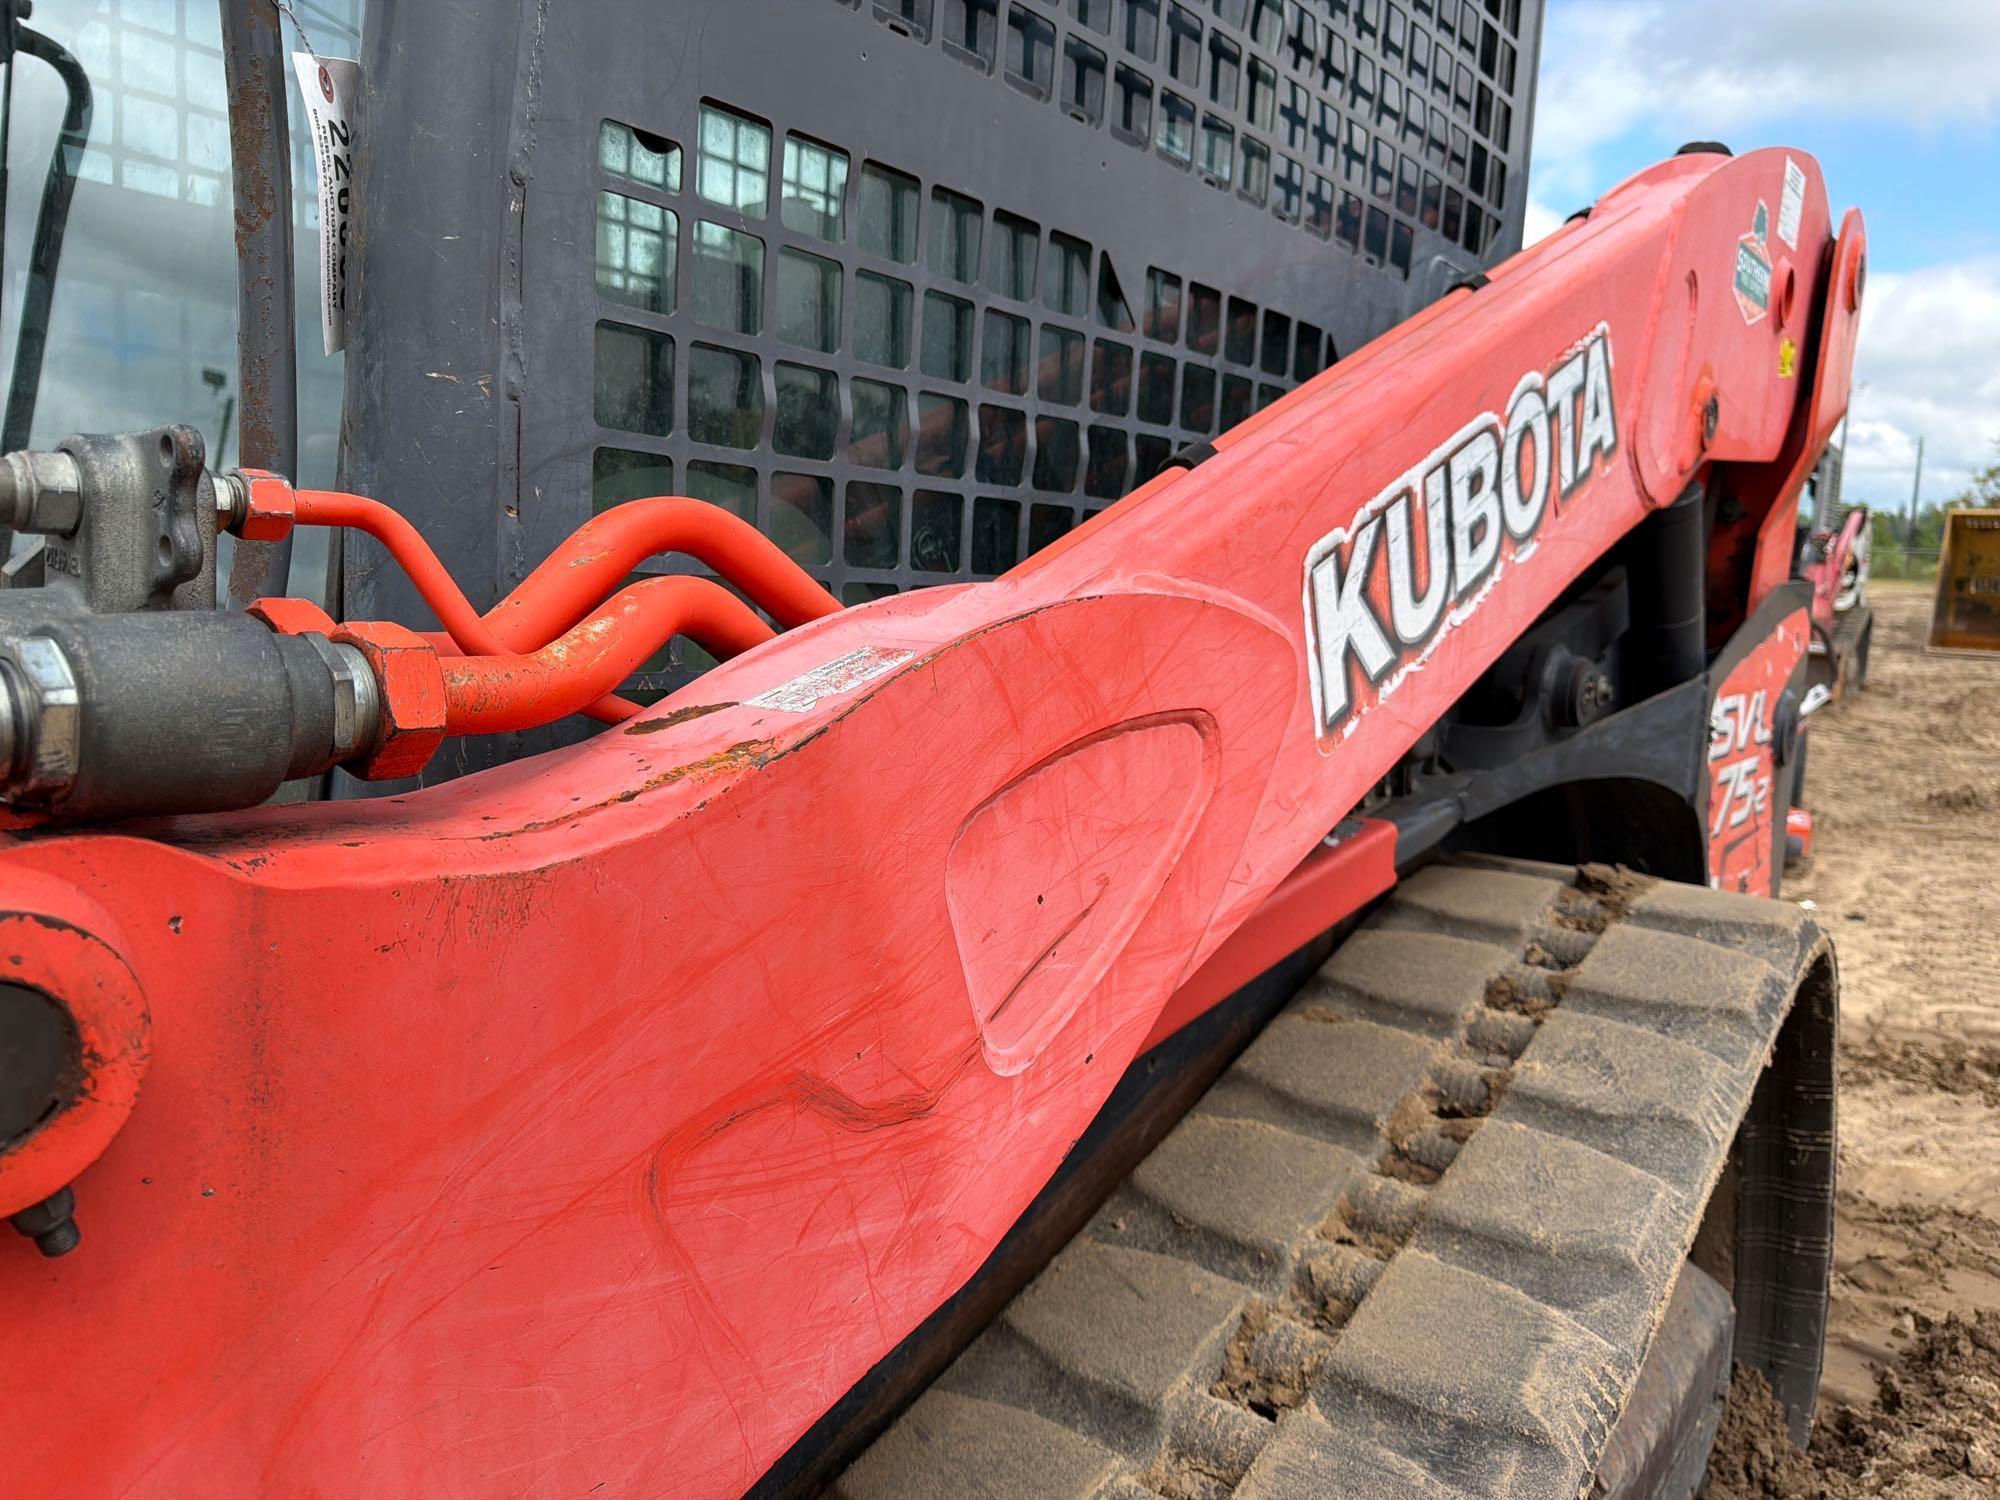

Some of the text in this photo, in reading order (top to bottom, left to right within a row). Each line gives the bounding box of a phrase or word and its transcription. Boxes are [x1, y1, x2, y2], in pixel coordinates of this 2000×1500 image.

[321, 125, 332, 173] REBEL
[328, 176, 336, 238] AUCTION
[1310, 334, 1617, 728] KUBOTA
[1710, 689, 1772, 761] SVL
